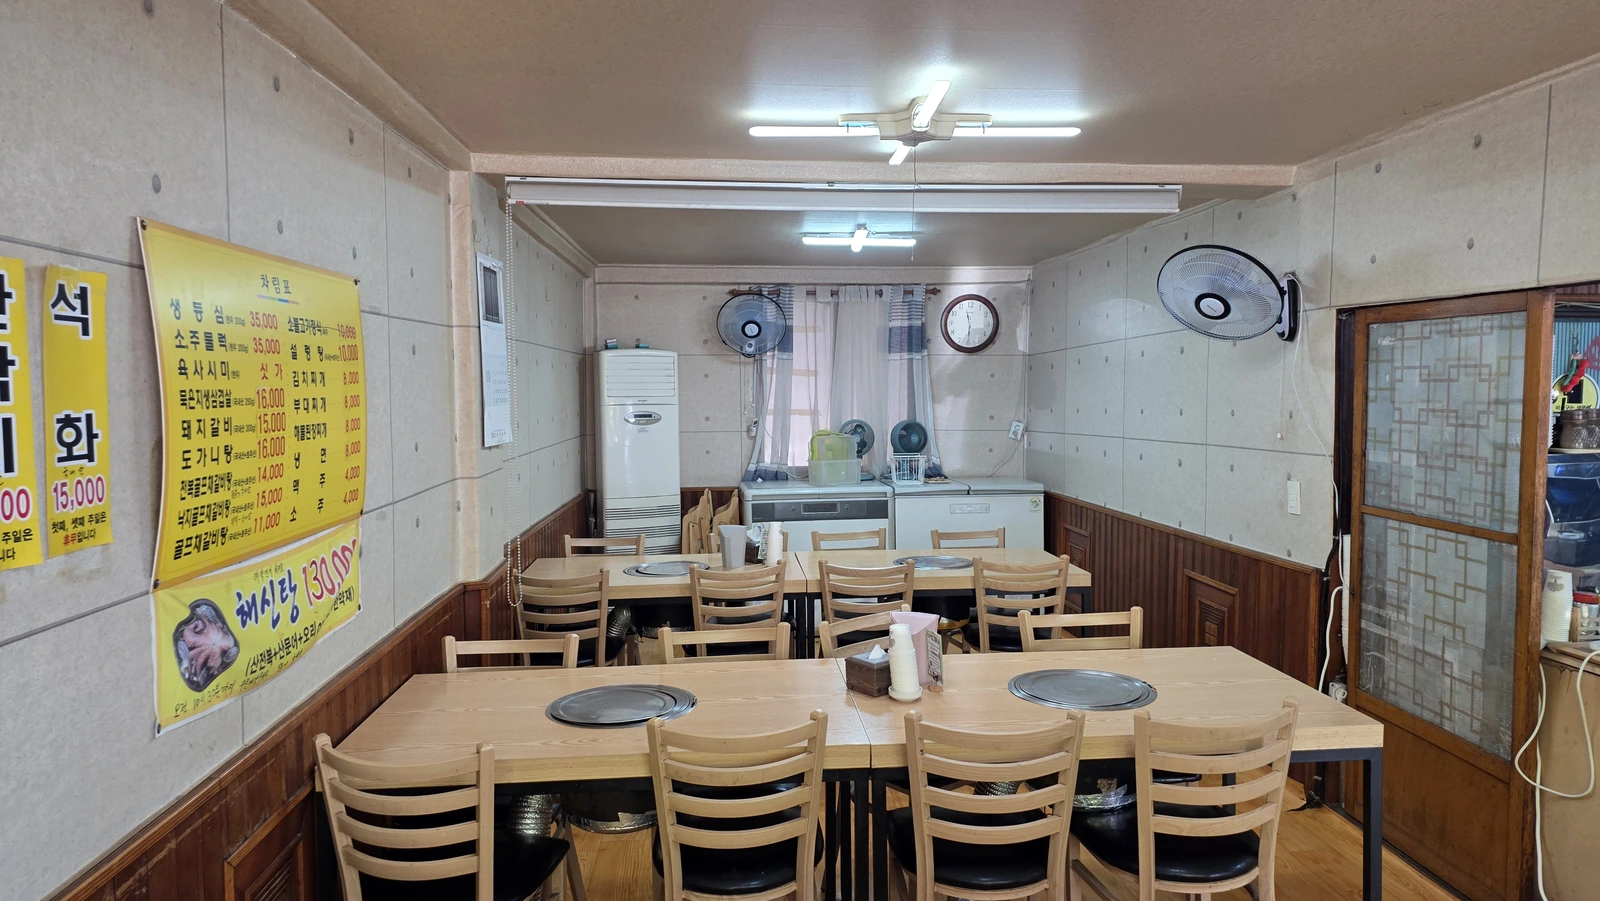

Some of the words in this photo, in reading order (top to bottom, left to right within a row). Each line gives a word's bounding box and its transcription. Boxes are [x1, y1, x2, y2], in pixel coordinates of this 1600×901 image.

[260, 274, 293, 295] 차림표
[249, 310, 278, 330] 35,000
[252, 336, 281, 356] 35,000
[338, 344, 359, 362] 10,000
[50, 283, 99, 463] 석화
[177, 358, 230, 380] 육사시미
[260, 362, 283, 381] 싯가
[292, 370, 326, 388] 김치찌개
[343, 371, 359, 386] 8,000
[179, 388, 232, 410] 묵은지생삼겹살
[256, 387, 285, 410] 16,000
[293, 396, 327, 415] 부대찌개
[344, 394, 360, 410] 8,000
[181, 416, 233, 440] 돼지갈비
[258, 411, 286, 434] 15,000
[345, 417, 361, 433] 8,000
[181, 444, 234, 470] 도가니탕
[257, 435, 286, 460] 16,000
[293, 447, 327, 470] 냉면
[345, 440, 361, 458] 8,000
[180, 471, 233, 501] 전복골프채갈비탕
[257, 462, 284, 483] 14,000
[292, 472, 326, 495] 맥주
[344, 465, 360, 482] 4,000
[53, 475, 105, 511] 15,000
[177, 498, 231, 530] 낙지골프채갈비탕
[256, 487, 283, 508] 15,000
[289, 497, 324, 522] 소주
[343, 488, 359, 505] 4,000
[87, 511, 107, 526] 주일은
[2, 528, 33, 544] 주일은
[63, 528, 96, 547] 휴무입니다
[173, 526, 229, 561] 골프채갈비탕
[254, 511, 281, 534] 11,000
[235, 568, 300, 630] 해신탕
